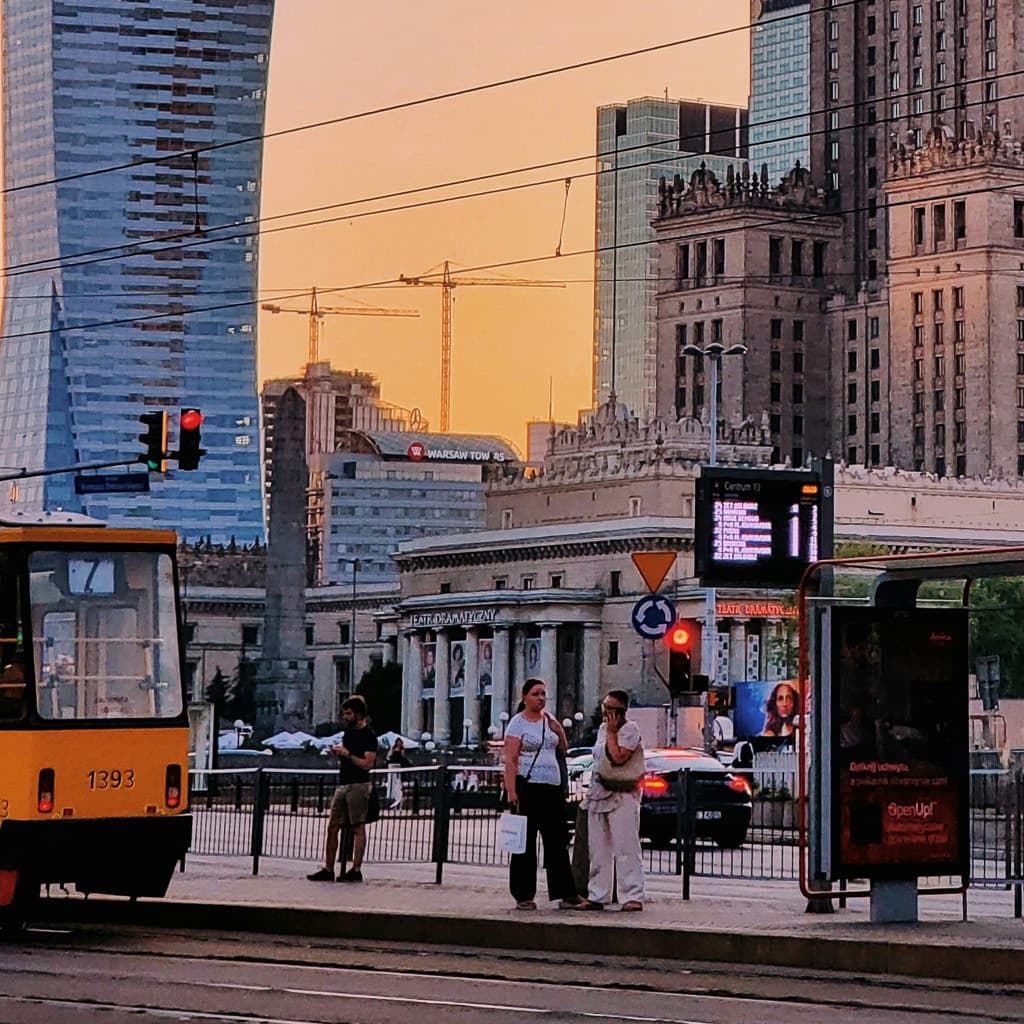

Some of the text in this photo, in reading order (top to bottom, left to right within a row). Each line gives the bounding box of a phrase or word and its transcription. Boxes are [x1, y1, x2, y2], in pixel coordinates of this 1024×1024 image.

[427, 449, 469, 460] WARSAW
[717, 603, 741, 614] TEATR
[435, 608, 496, 625] DRAMATYCZNY
[88, 769, 135, 789] 1393
